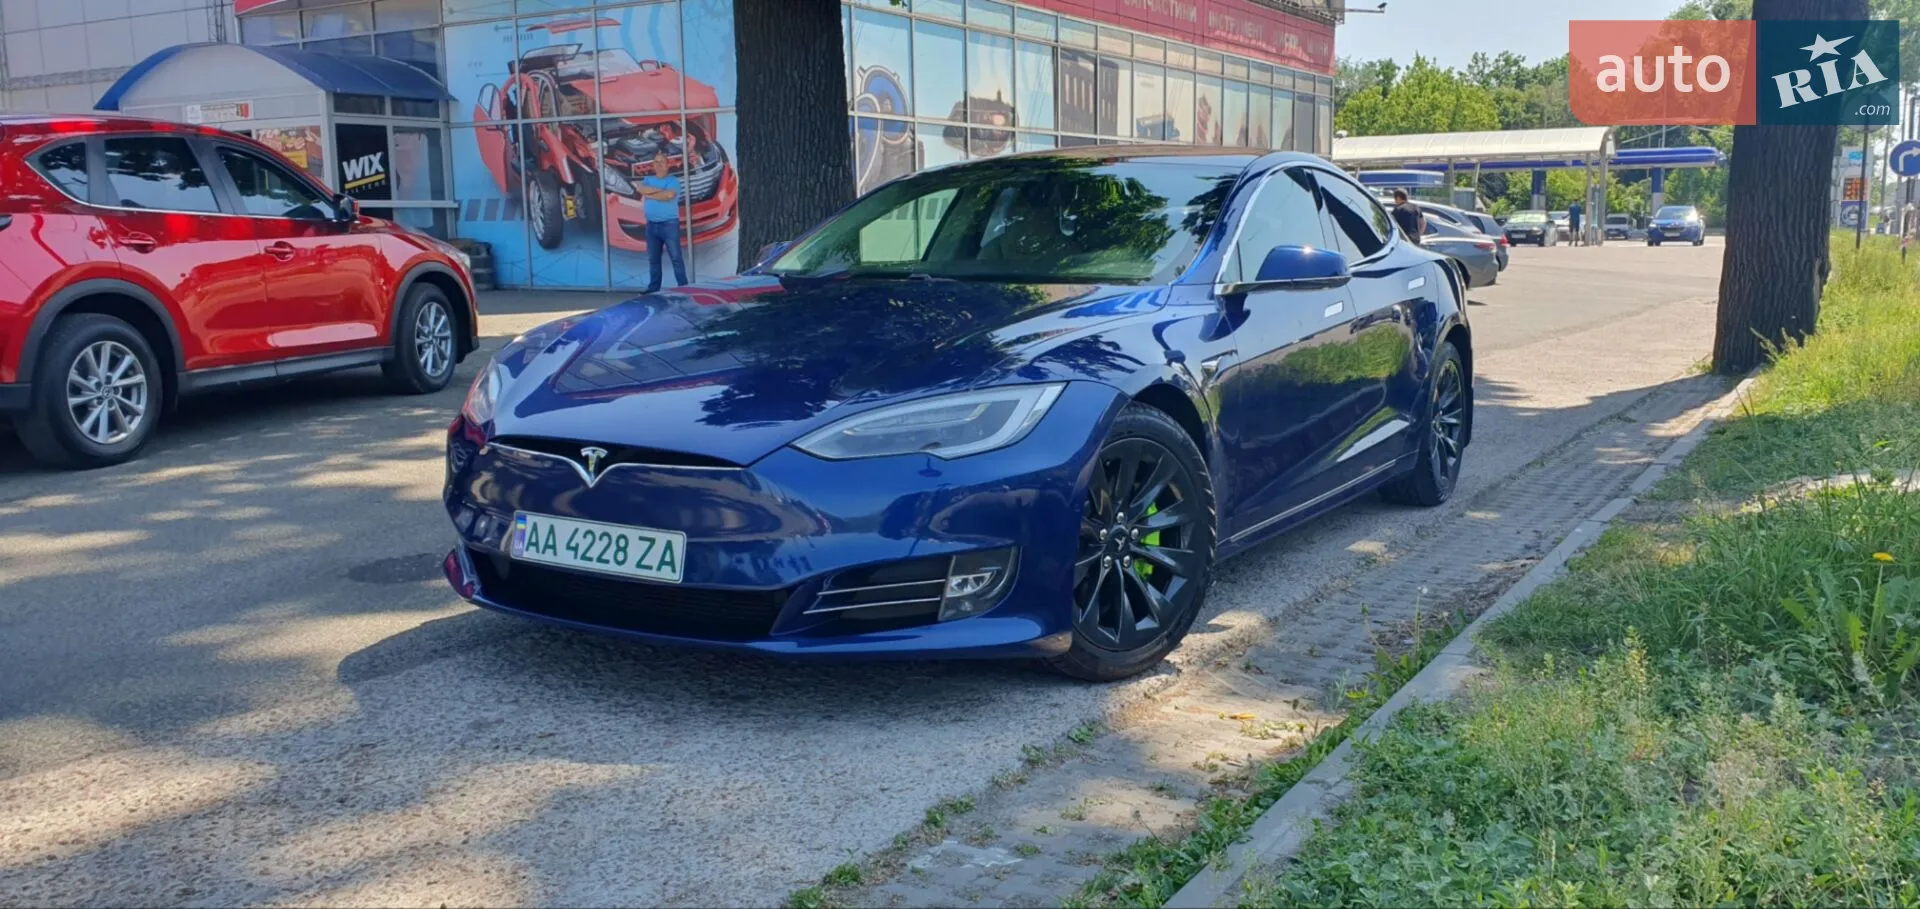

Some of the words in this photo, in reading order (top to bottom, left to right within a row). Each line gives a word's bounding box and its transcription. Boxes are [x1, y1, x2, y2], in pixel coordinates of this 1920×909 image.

[342, 152, 385, 182] WIX
[525, 521, 558, 557] AA
[565, 527, 629, 567] 4228
[635, 535, 677, 574] ZA
